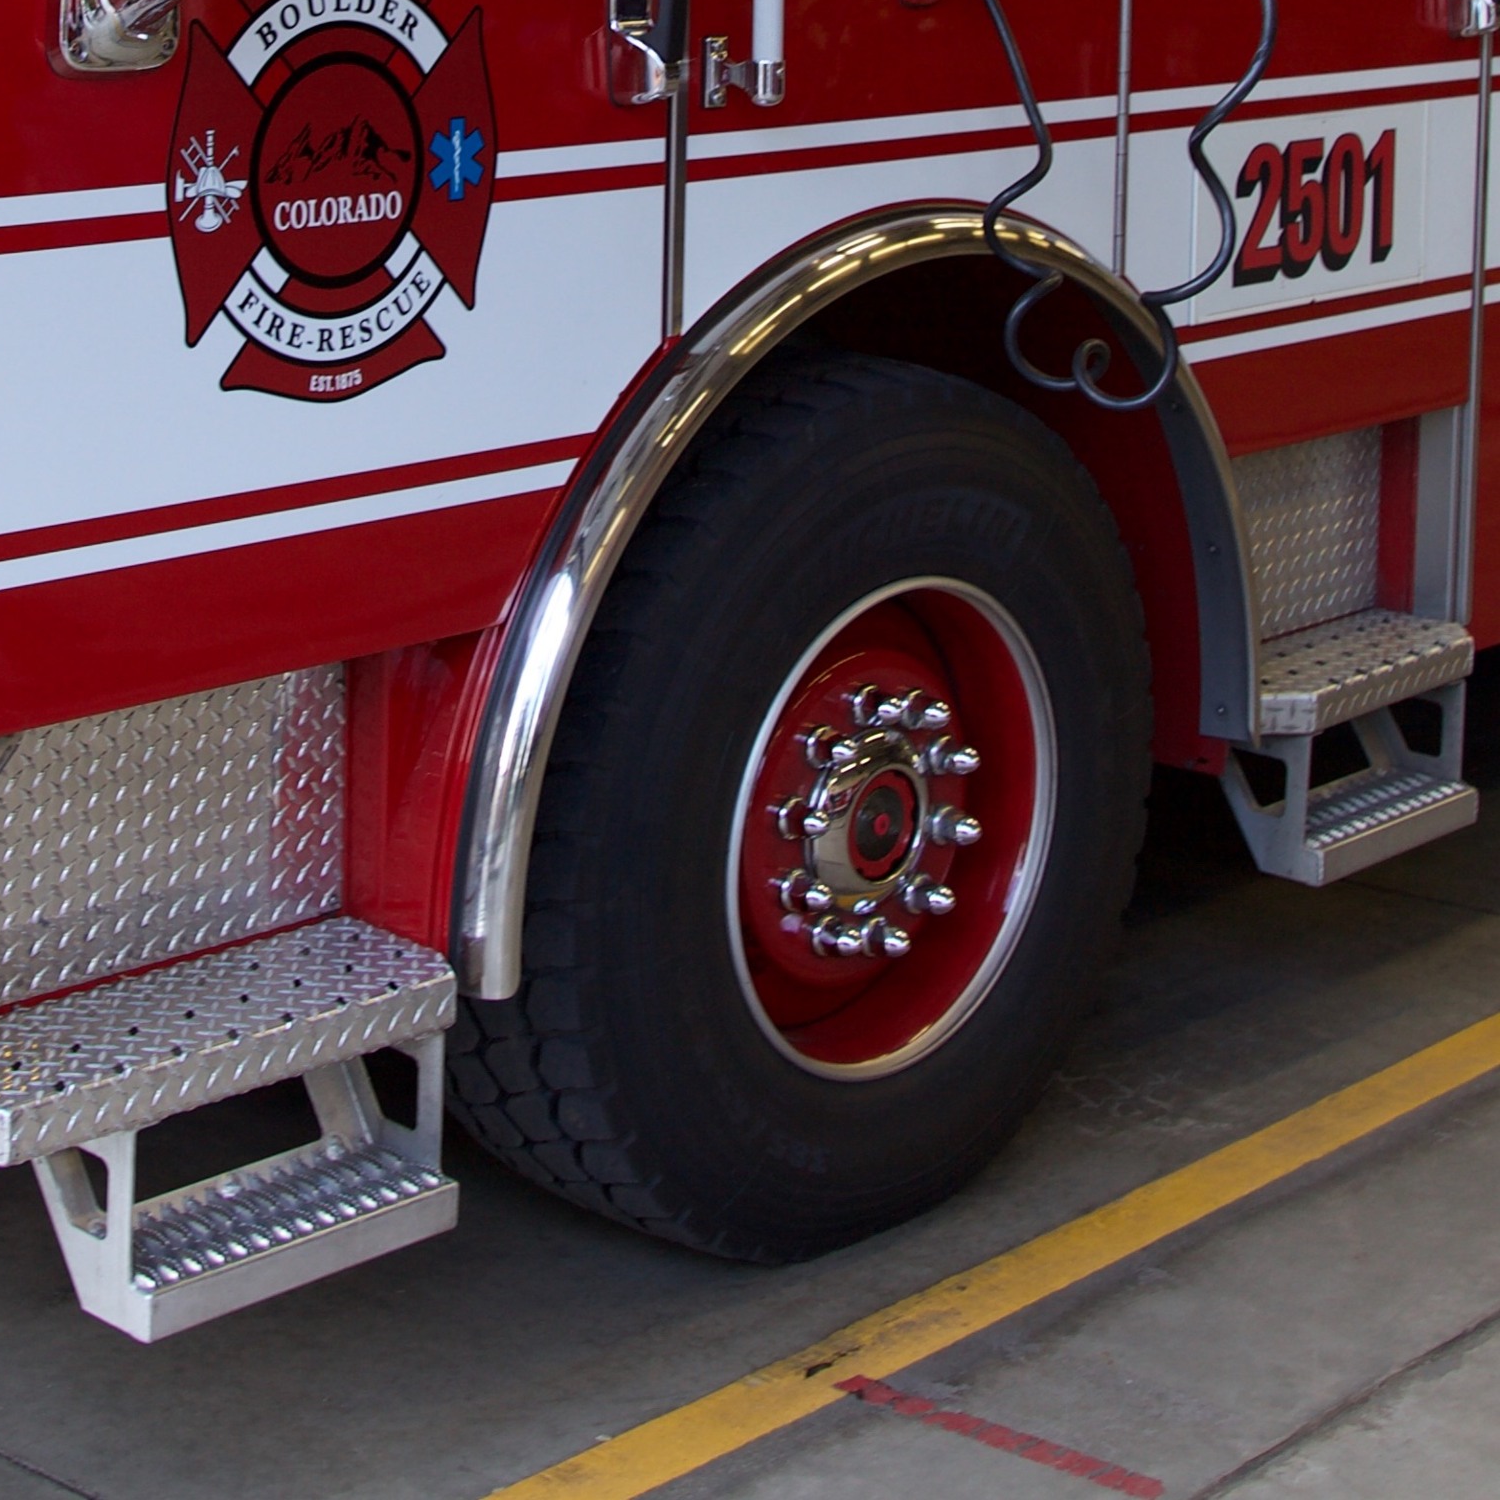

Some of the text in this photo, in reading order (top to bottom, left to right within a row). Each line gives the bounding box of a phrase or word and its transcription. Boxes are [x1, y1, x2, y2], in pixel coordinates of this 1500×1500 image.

[274, 190, 402, 232] COLORADO
[1232, 127, 1397, 288] 2501
[237, 269, 432, 354] FIRE-RESCUE
